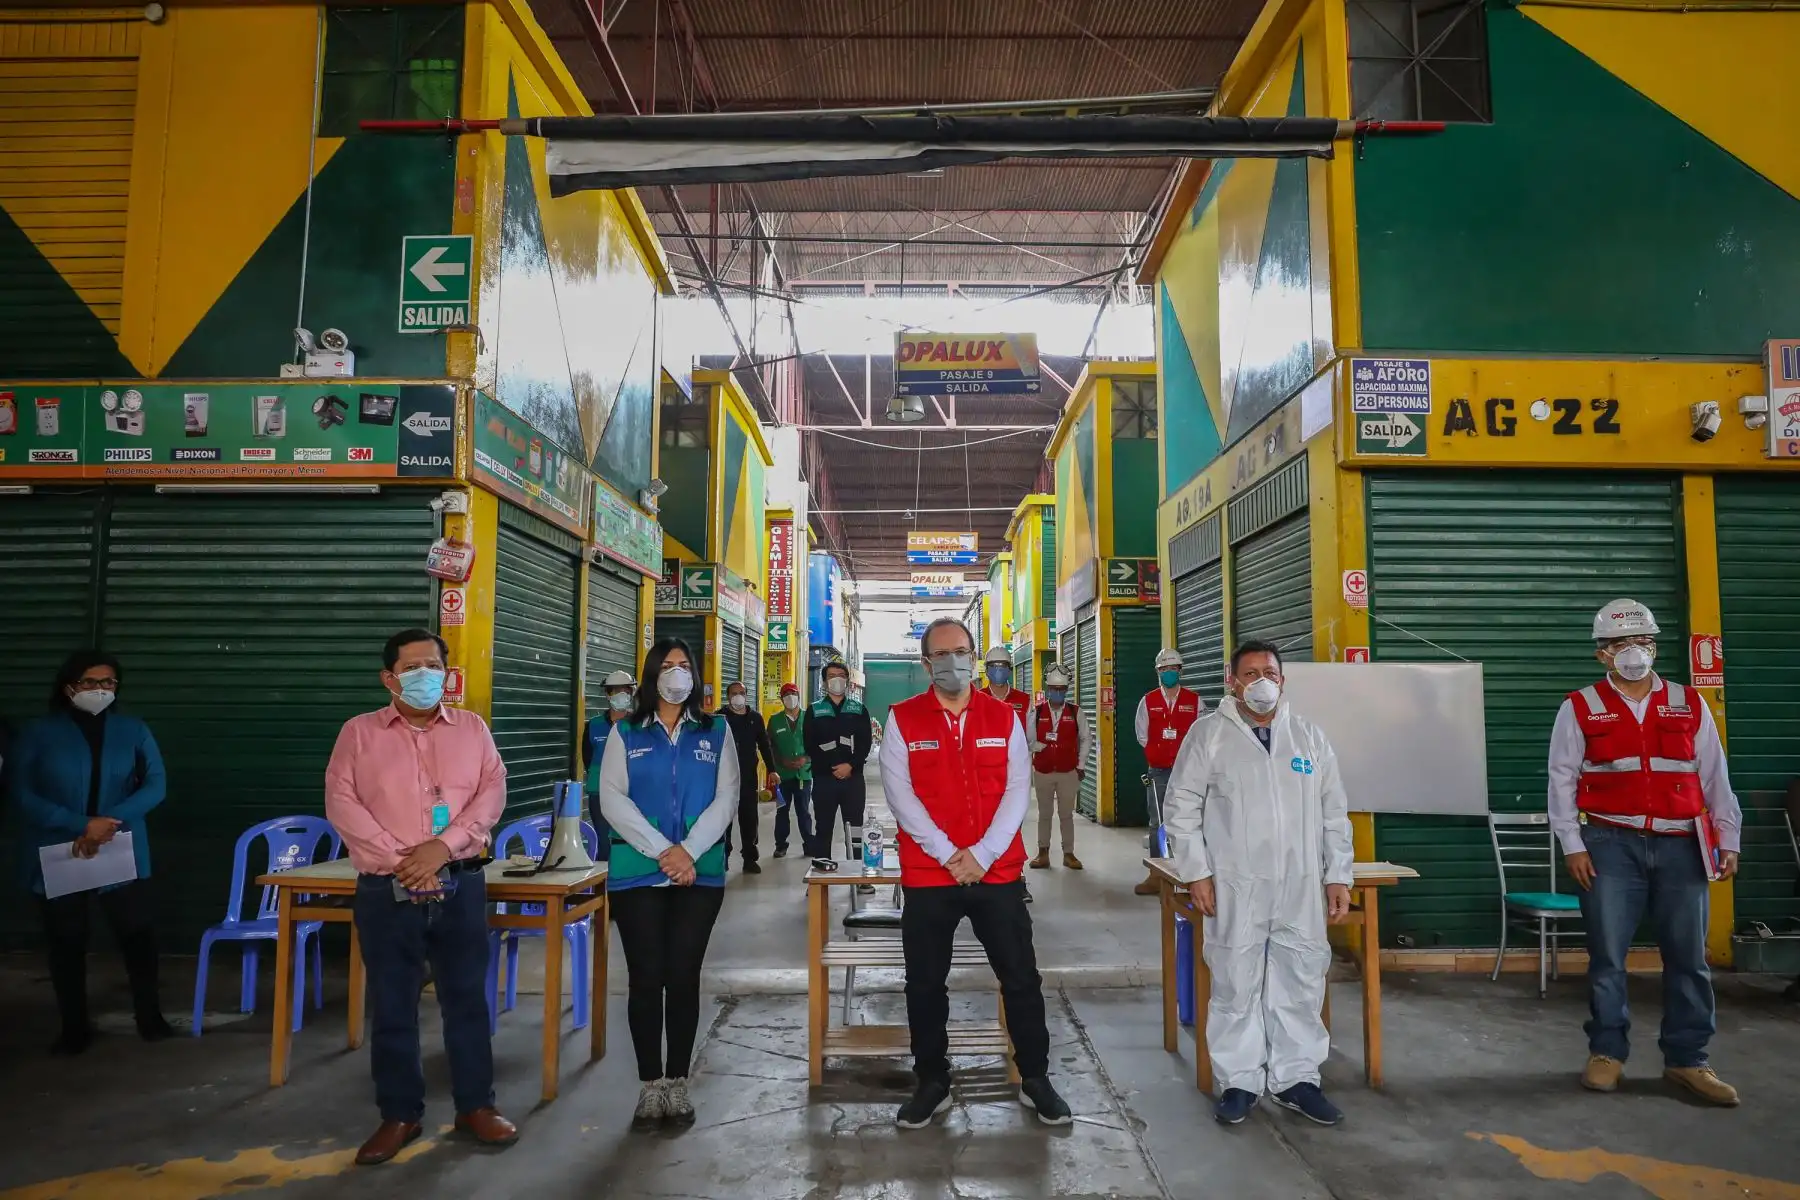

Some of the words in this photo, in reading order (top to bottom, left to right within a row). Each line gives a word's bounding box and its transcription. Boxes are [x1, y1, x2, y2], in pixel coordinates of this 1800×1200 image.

[405, 307, 465, 326] SALIDA
[896, 341, 1006, 363] OPALUX
[940, 370, 984, 380] PASAJE
[987, 370, 994, 379] 9
[1377, 368, 1428, 382] AFORO
[946, 383, 989, 393] SALIDA
[1355, 383, 1396, 392] CAPACIDAD
[1398, 383, 1428, 392] MAXIMA
[1357, 396, 1375, 407] 28
[1378, 396, 1429, 409] PERSONAS
[1443, 398, 1518, 437] AG
[1552, 398, 1621, 435] 22
[410, 420, 448, 428] SALIDA
[1364, 423, 1413, 437] SALIDA
[105, 450, 151, 460] PHILIPS
[183, 450, 216, 459] DIXON
[349, 448, 372, 460] 3M
[401, 455, 452, 466] SALIDA
[106, 467, 154, 475] Atendemos
[165, 467, 186, 475] Nivel
[189, 467, 228, 475] Nacional
[231, 467, 239, 475] al
[241, 466, 257, 474] Por
[259, 468, 287, 476] mayor
[297, 466, 326, 474] Menor
[907, 536, 960, 545] CELAPSA
[911, 575, 953, 584] OPALUX
[1109, 587, 1137, 595] SALIDA
[682, 599, 712, 610] SALIDA
